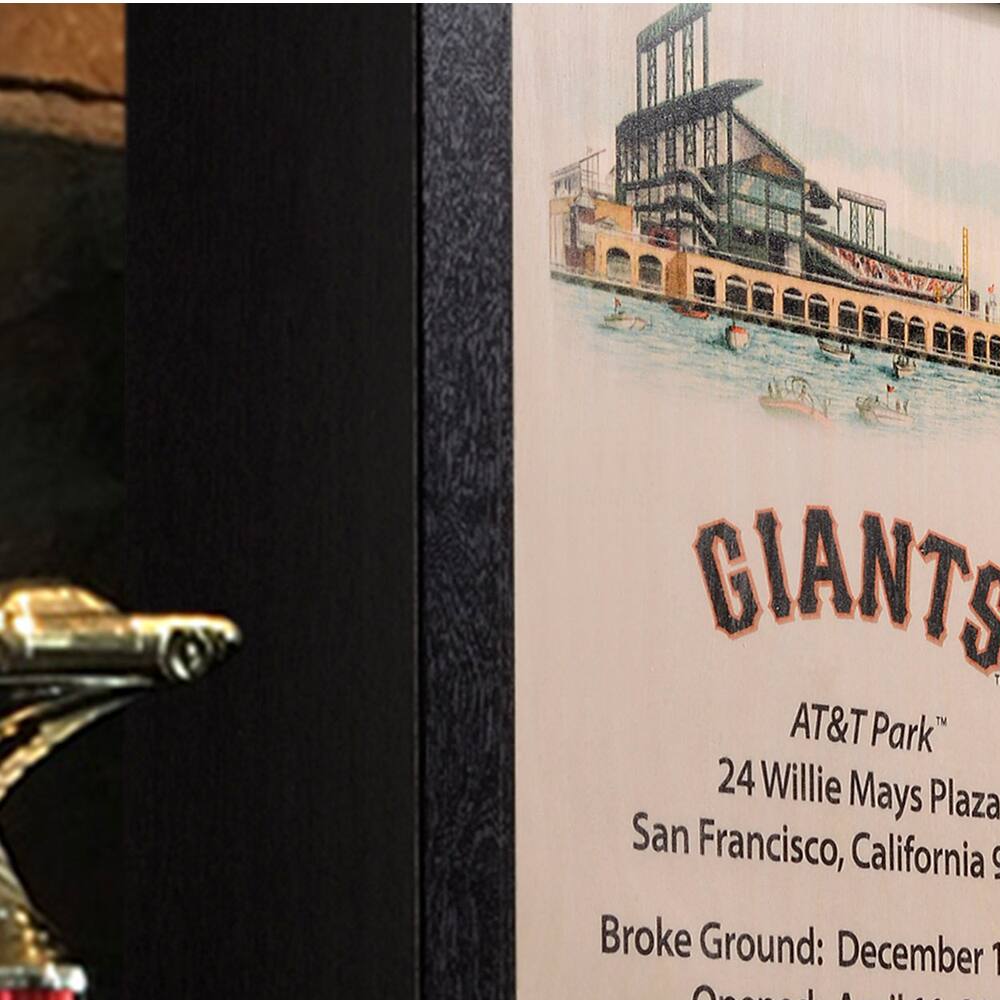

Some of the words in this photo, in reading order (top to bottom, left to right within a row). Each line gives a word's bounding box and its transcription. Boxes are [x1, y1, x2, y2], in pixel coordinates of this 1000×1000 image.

[790, 701, 869, 745] AT&T
[718, 757, 755, 796] 24
[760, 759, 842, 804] Willie
[849, 769, 922, 821] Mays
[930, 777, 1000, 820] Plaza
[632, 811, 690, 855] San
[699, 818, 845, 872] Francisco,
[851, 831, 985, 879] California
[601, 914, 692, 959] Broke
[699, 921, 824, 966] Ground:
[837, 930, 984, 975] December
